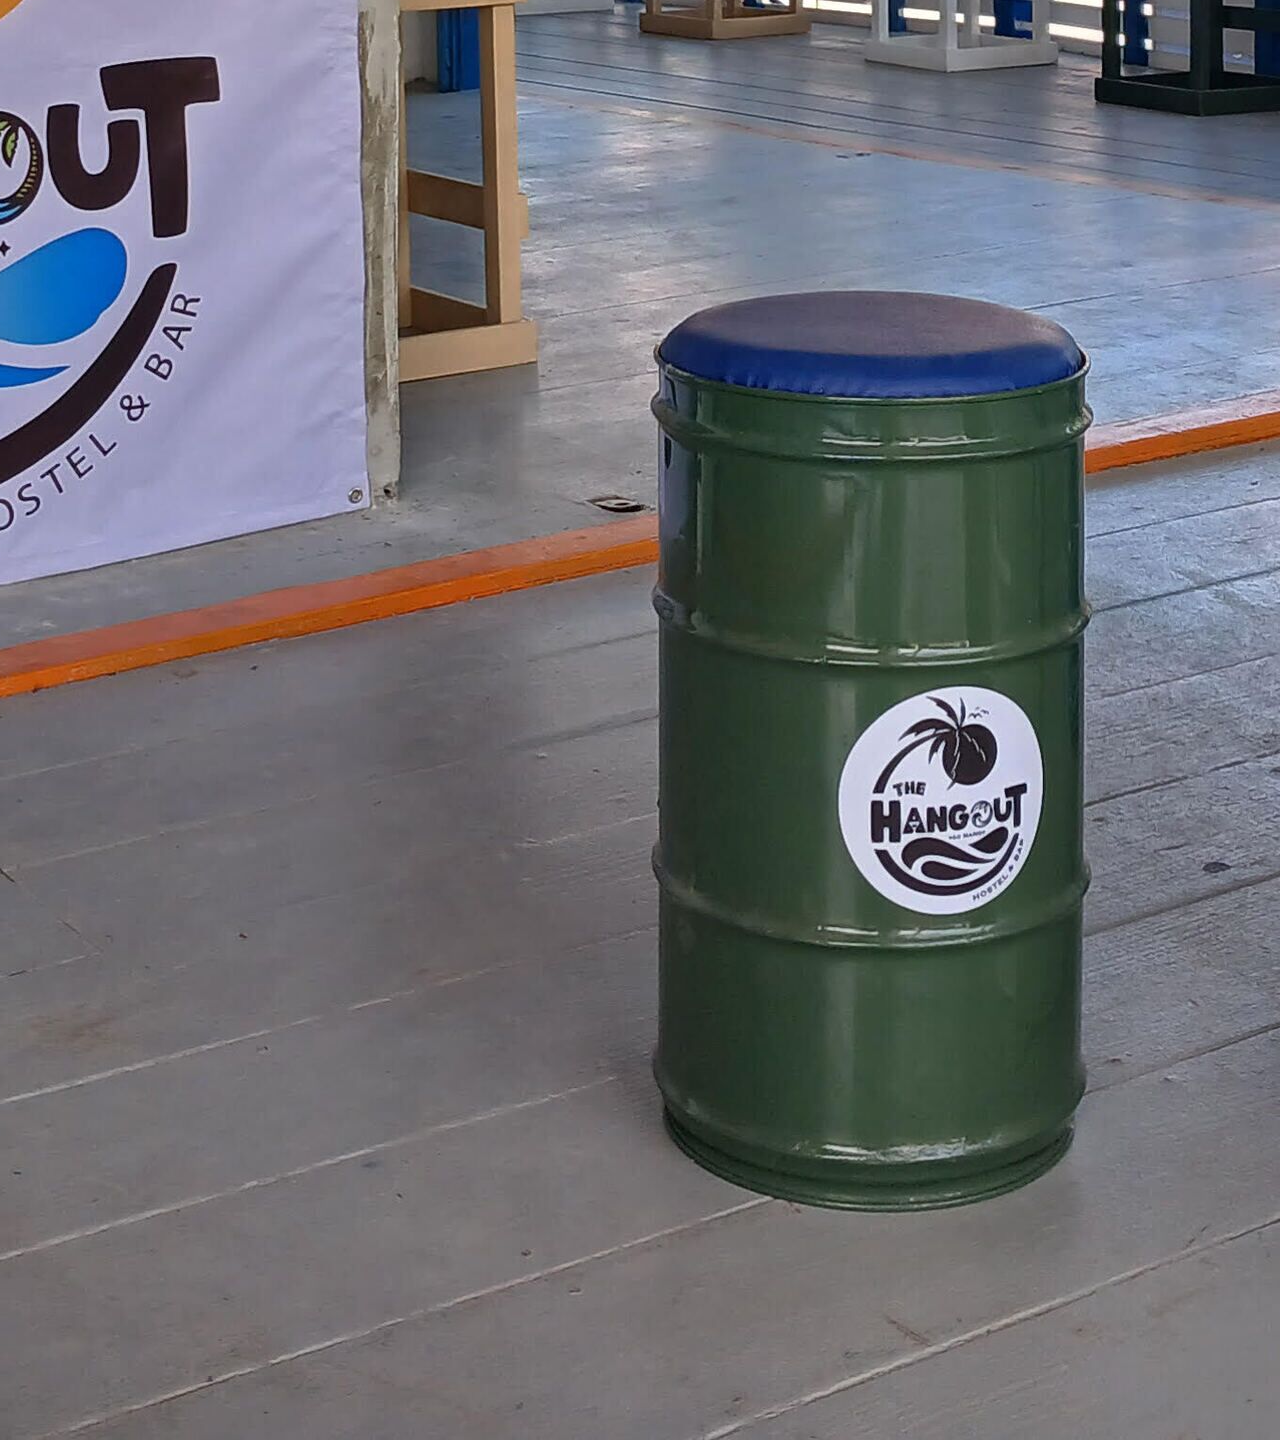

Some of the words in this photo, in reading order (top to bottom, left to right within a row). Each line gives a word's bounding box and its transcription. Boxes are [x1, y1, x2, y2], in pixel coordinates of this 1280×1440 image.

[119, 393, 152, 422] &
[144, 292, 202, 381] BAR
[870, 782, 1028, 844] HANGOUT
[892, 780, 927, 797] THE
